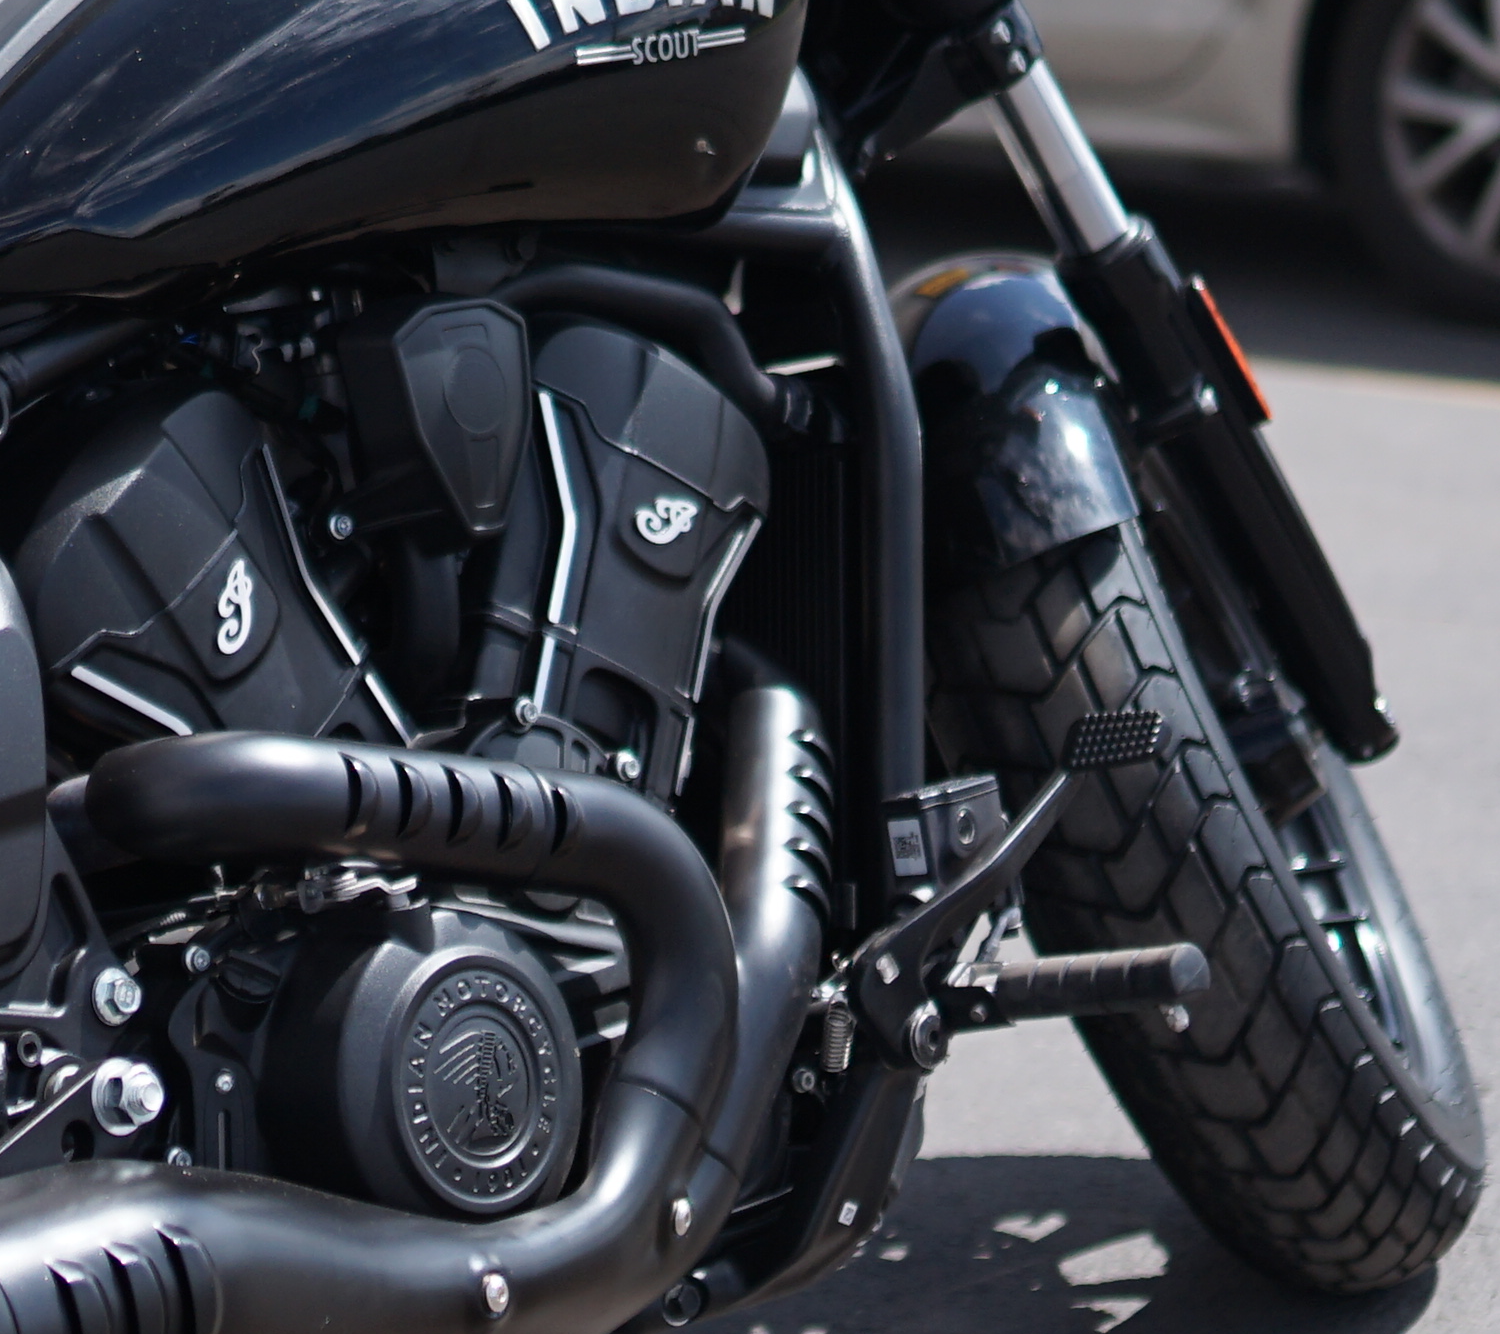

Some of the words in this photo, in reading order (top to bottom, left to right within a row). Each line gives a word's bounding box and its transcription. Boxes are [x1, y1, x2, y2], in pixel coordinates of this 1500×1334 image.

[631, 29, 701, 66] SCOUT
[406, 1021, 449, 1169] INDIAN
[431, 974, 559, 1135] MOTORCYCLE
[471, 1156, 529, 1194] 1901
